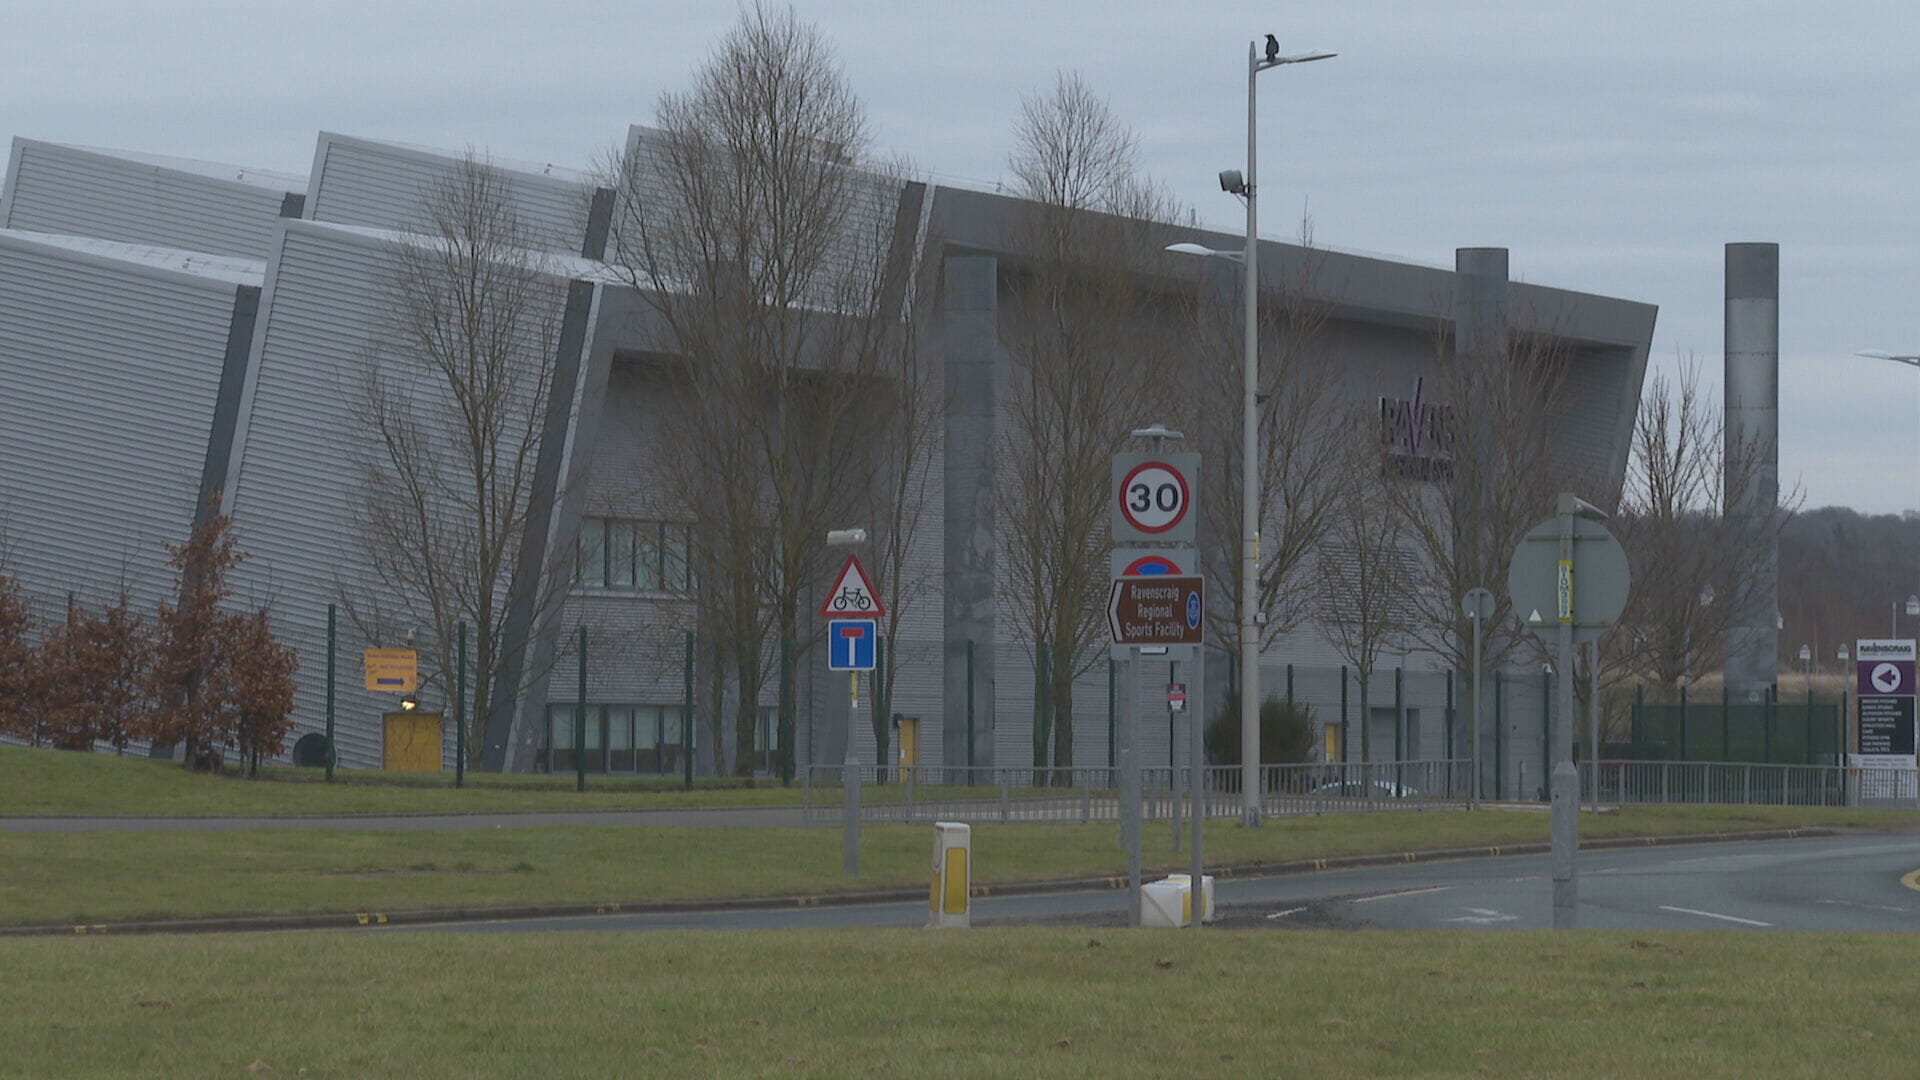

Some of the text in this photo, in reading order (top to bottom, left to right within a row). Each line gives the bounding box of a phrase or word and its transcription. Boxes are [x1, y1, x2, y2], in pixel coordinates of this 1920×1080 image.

[1130, 483, 1178, 512] 30
[1131, 584, 1180, 602] Ravenscraig
[1138, 602, 1173, 620] Regional
[1125, 621, 1185, 640] Sports Facility
